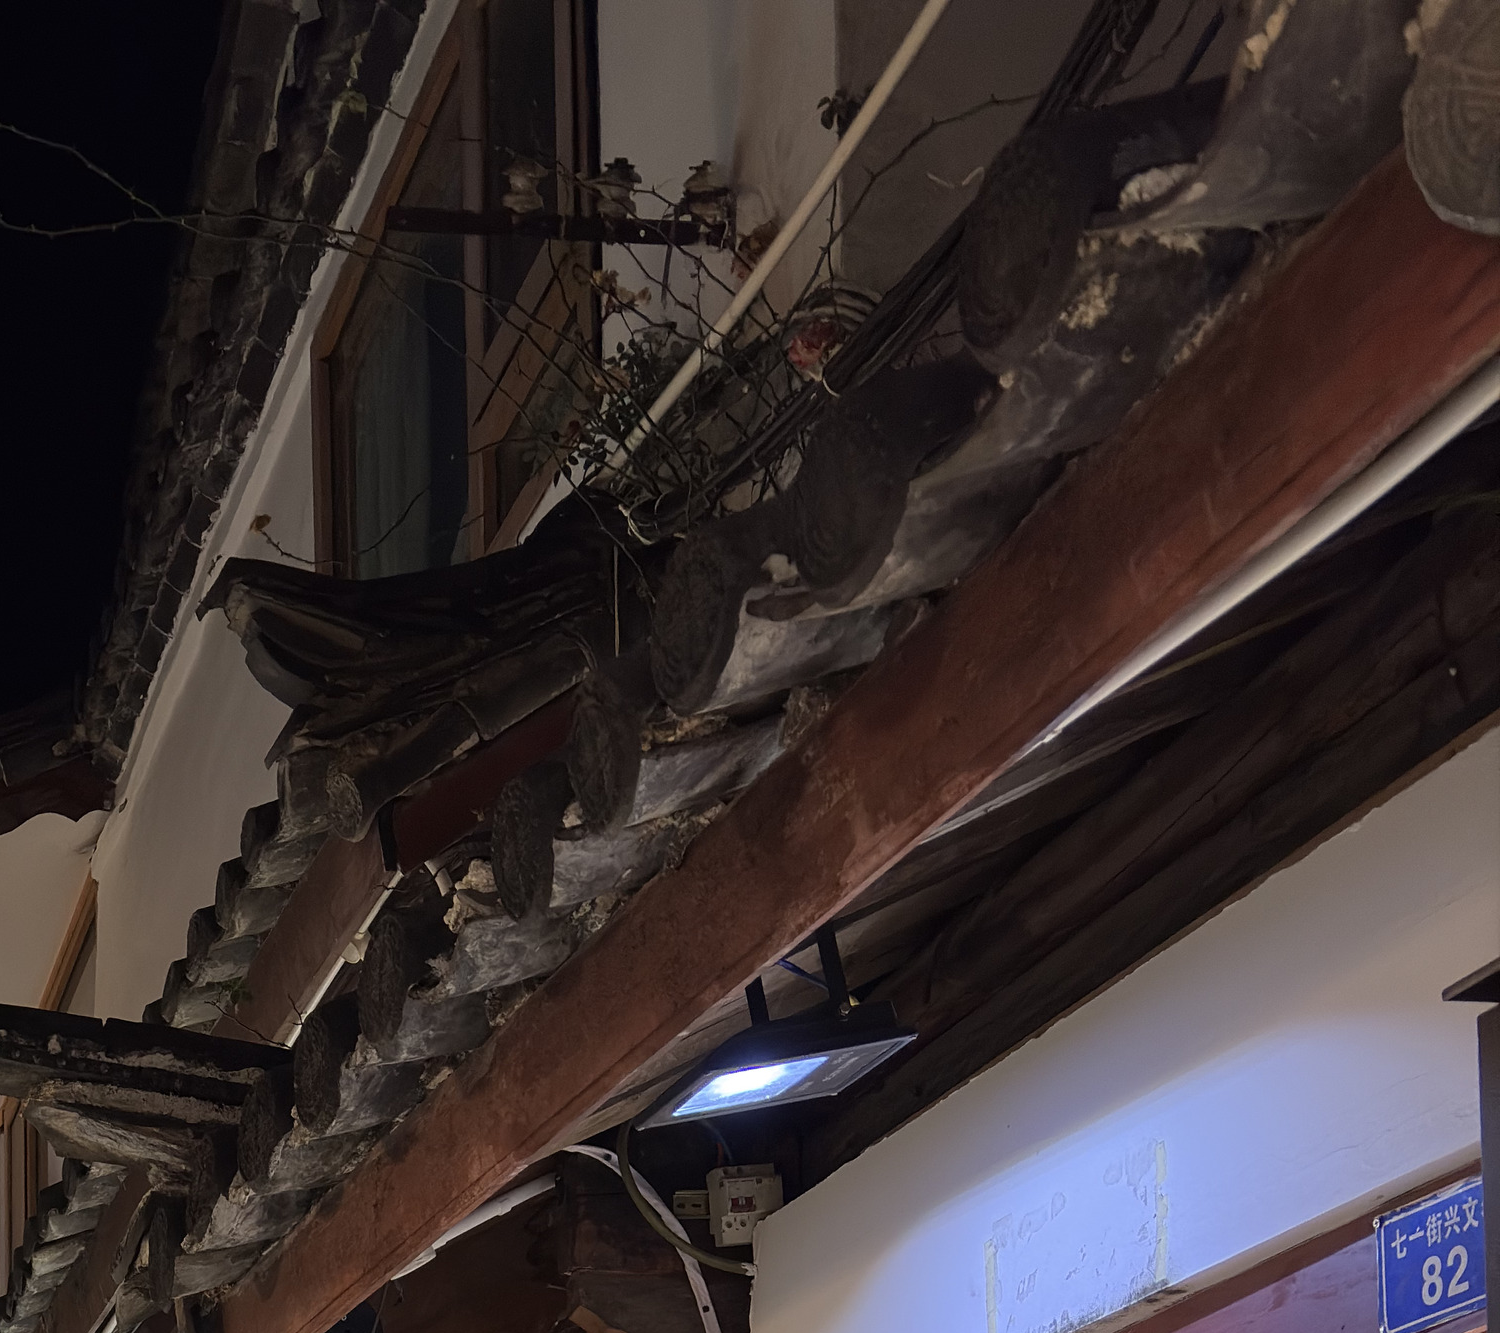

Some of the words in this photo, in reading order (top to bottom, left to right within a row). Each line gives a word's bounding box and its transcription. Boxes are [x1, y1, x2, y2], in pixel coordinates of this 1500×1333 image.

[1391, 1197, 1484, 1259] 七一街兴文
[1421, 1245, 1470, 1306] 82
